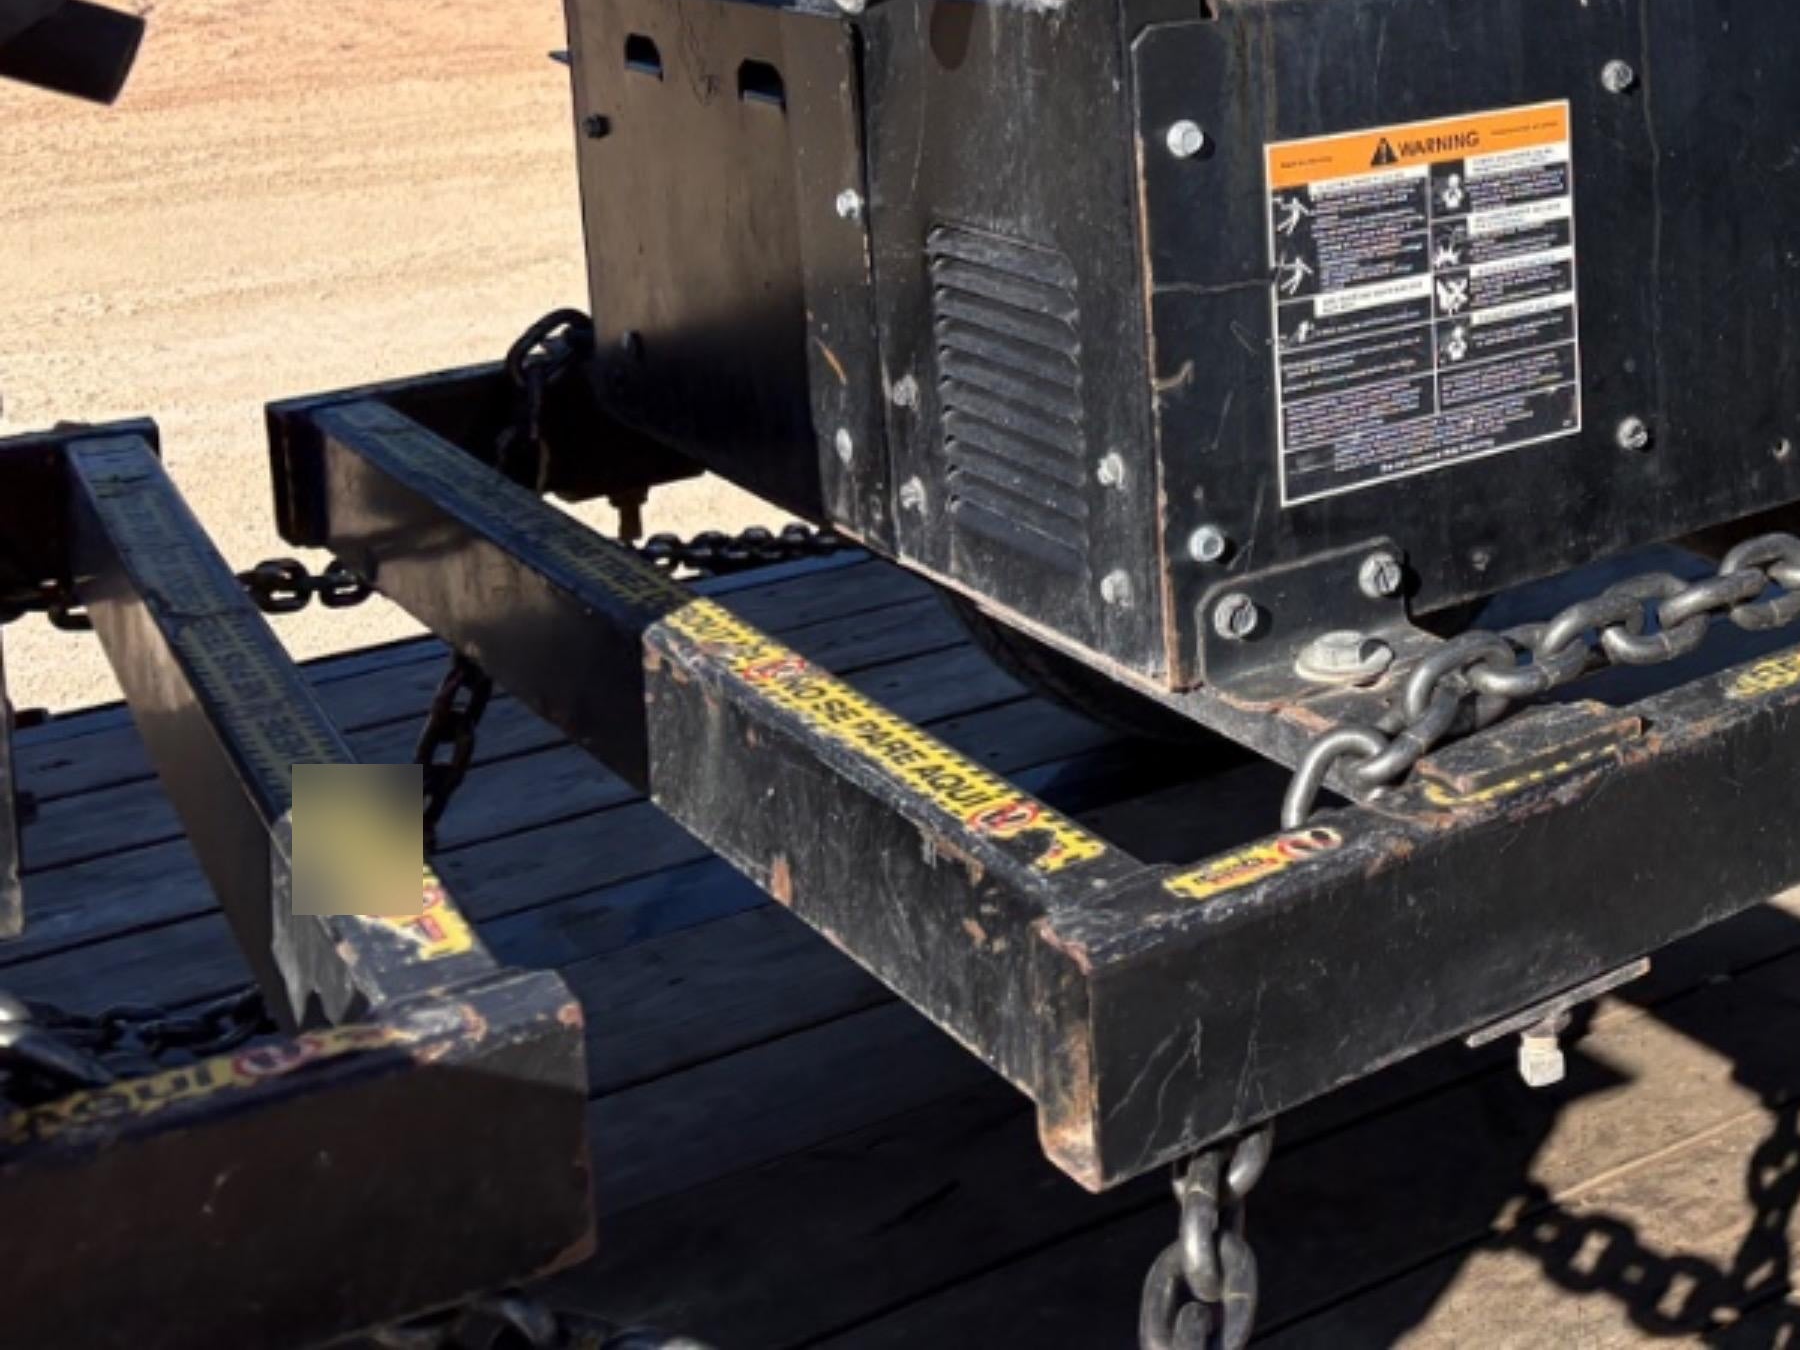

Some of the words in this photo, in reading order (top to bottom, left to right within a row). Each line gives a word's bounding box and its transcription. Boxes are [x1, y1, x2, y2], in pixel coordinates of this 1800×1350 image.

[1398, 131, 1480, 157] WARNING
[855, 718, 930, 766] PARE
[909, 763, 993, 808] AQUI
